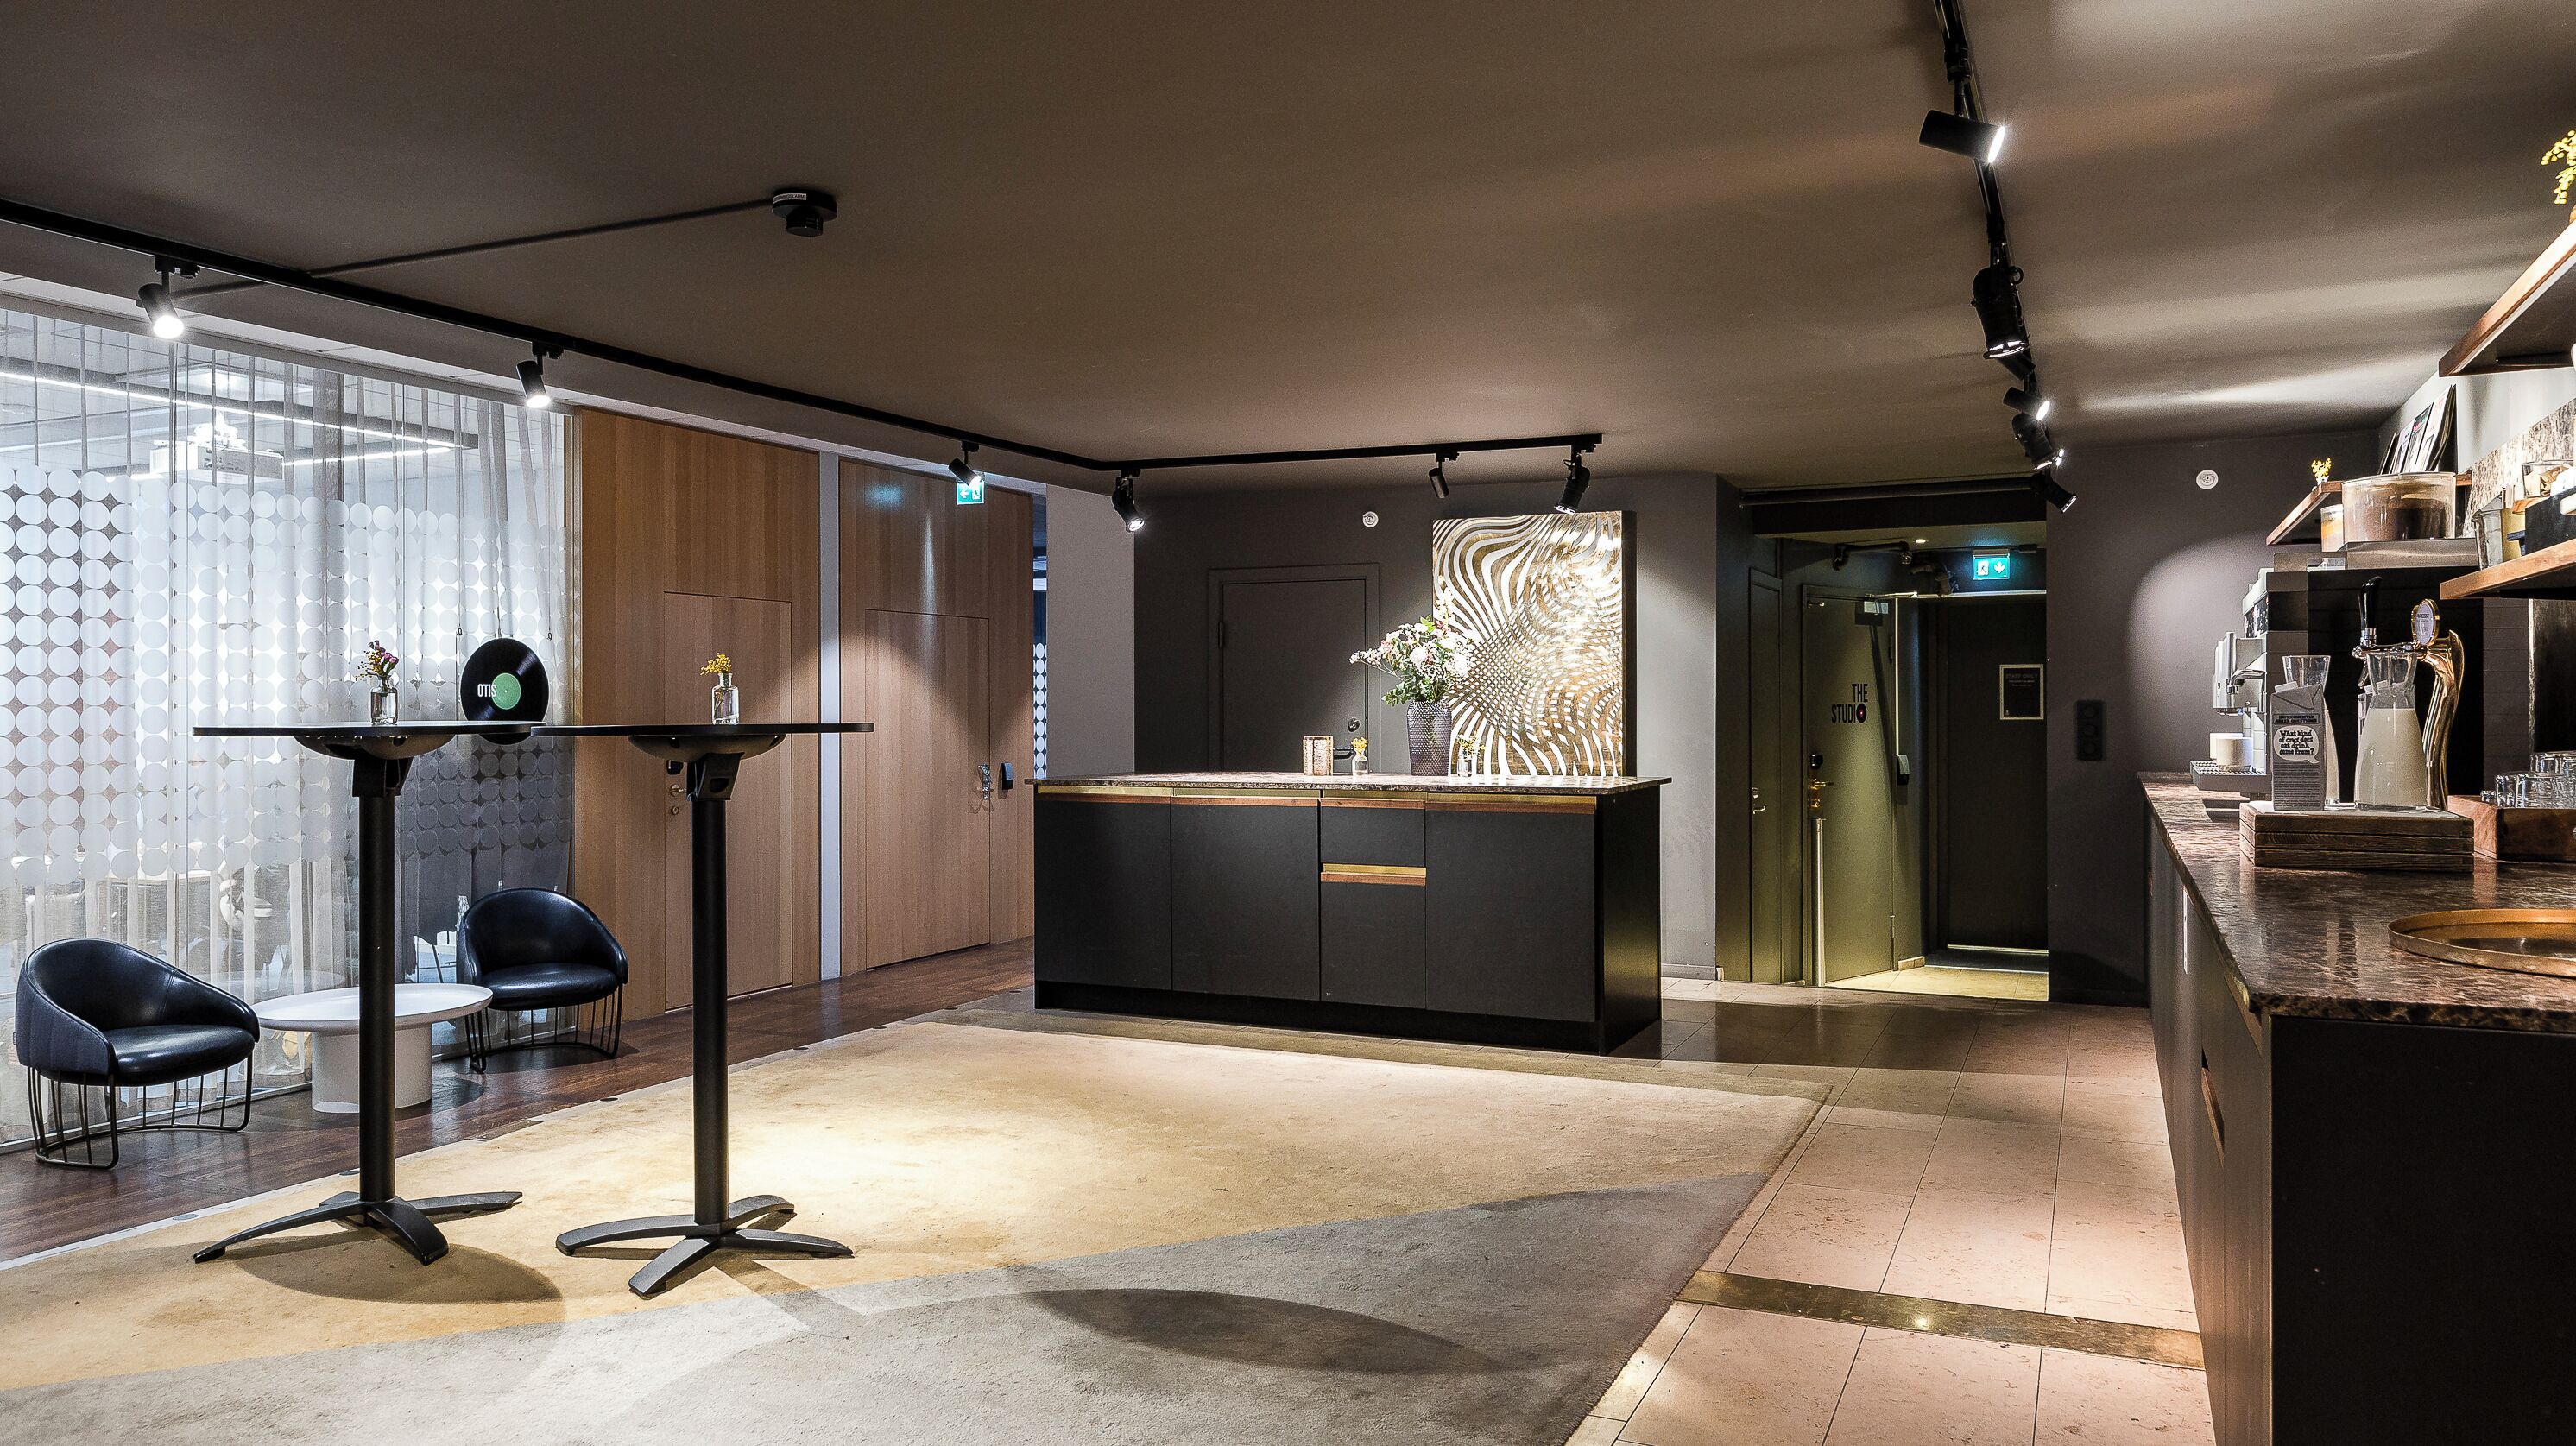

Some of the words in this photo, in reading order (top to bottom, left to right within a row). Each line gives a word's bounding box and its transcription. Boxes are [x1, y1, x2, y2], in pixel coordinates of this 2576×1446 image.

[477, 683, 497, 698] OTIS
[1852, 683, 1868, 703] THE
[1831, 703, 1867, 723] STUDIO
